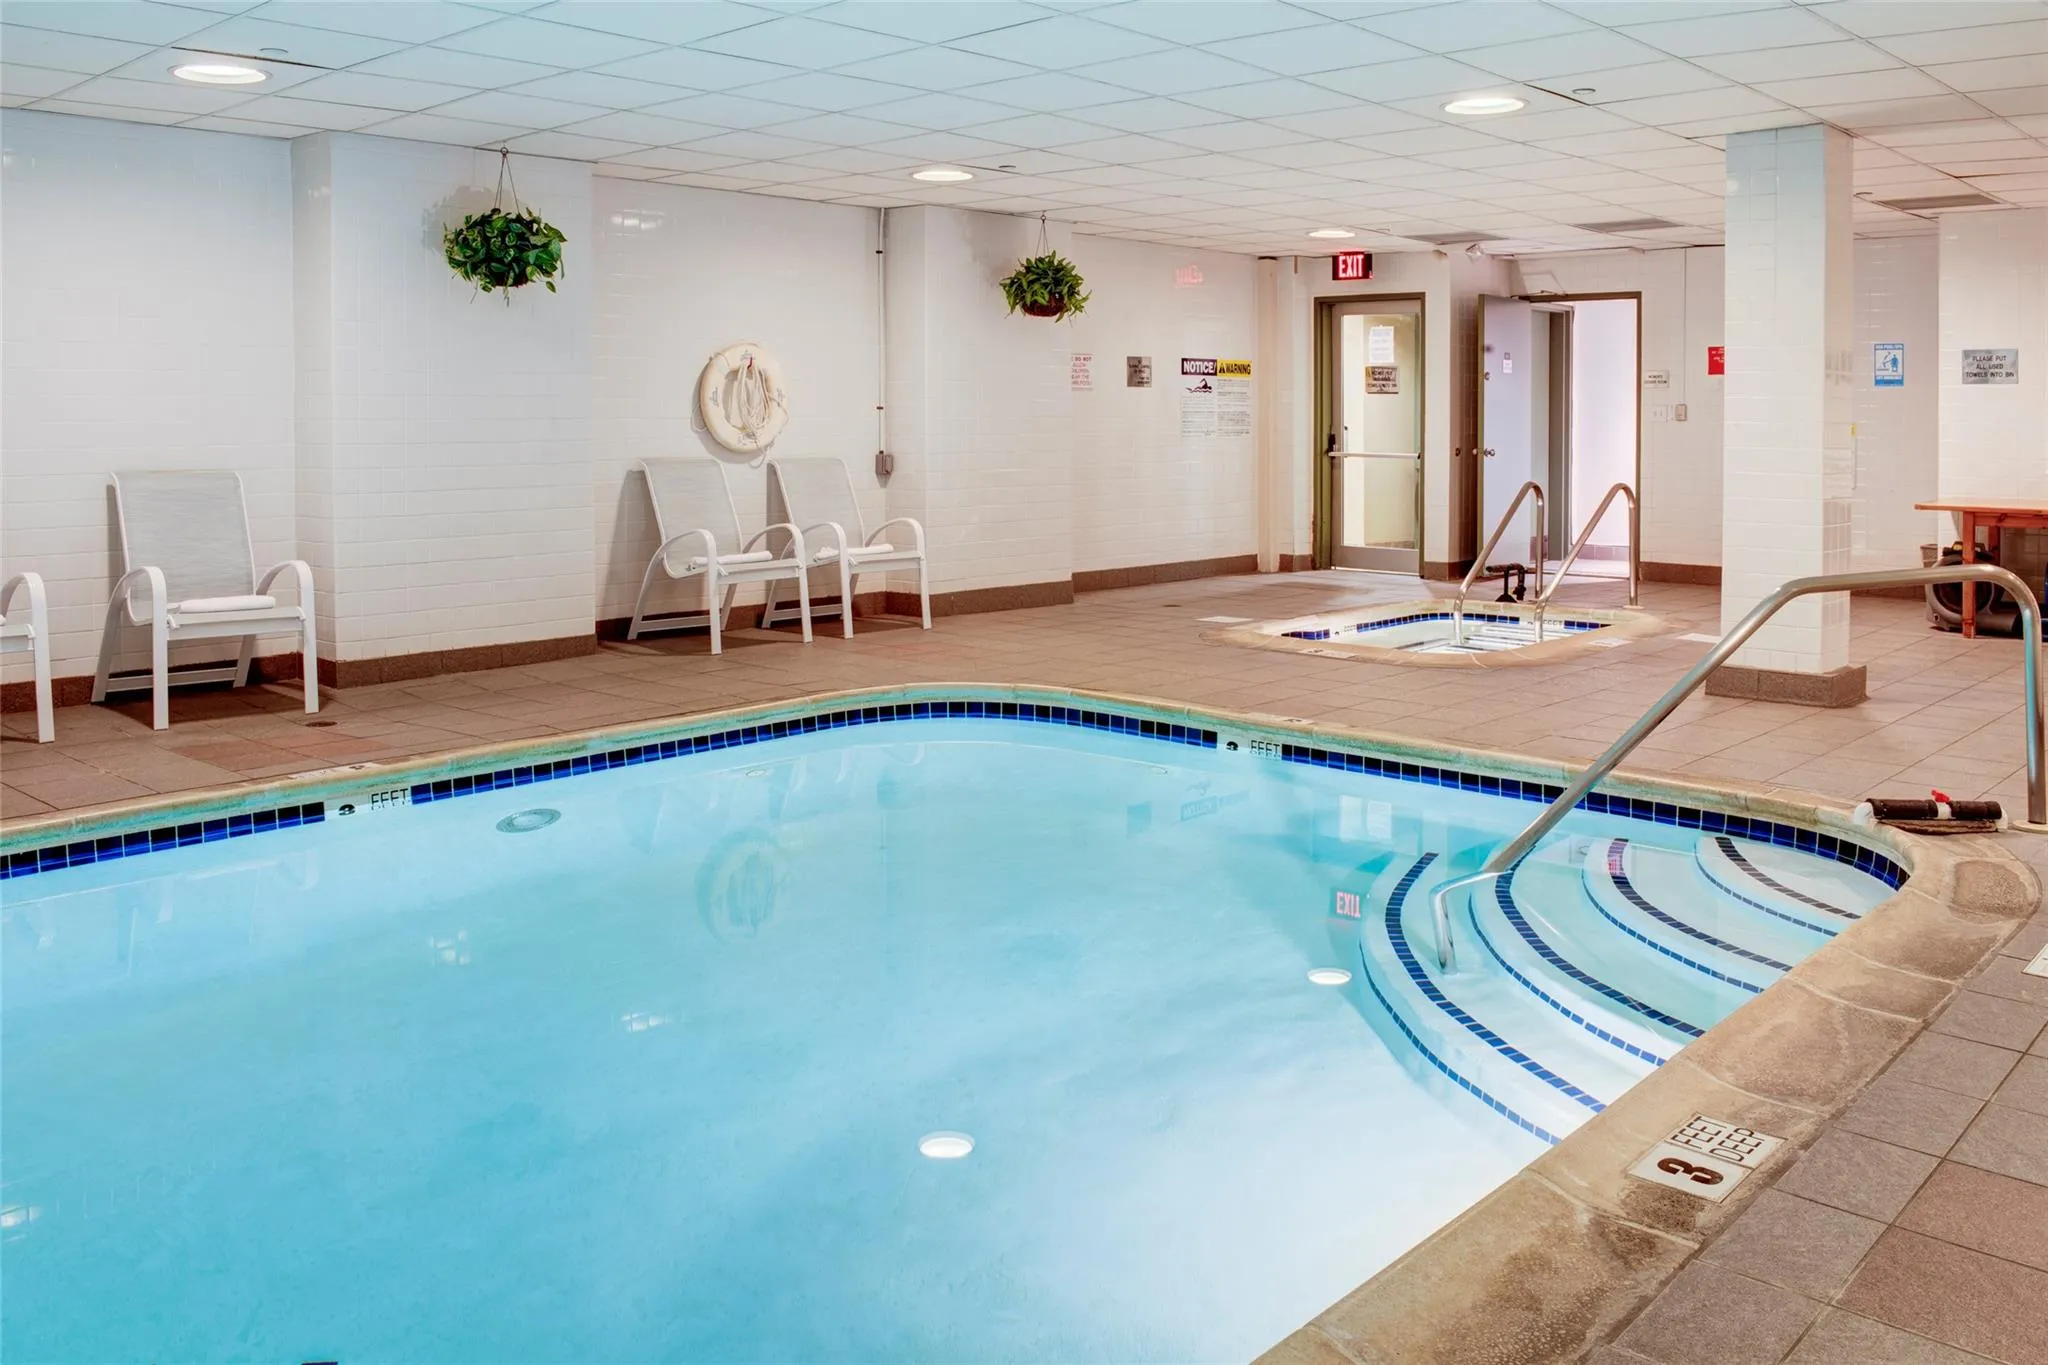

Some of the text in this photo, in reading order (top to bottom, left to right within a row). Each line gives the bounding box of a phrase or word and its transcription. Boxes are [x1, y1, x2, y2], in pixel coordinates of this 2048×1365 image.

[1338, 254, 1364, 278] EXIT
[1225, 362, 1251, 375] WARNING
[1670, 1115, 1728, 1150] FEET
[1709, 1127, 1765, 1162] DEEP
[1657, 1157, 1724, 1185] 3
